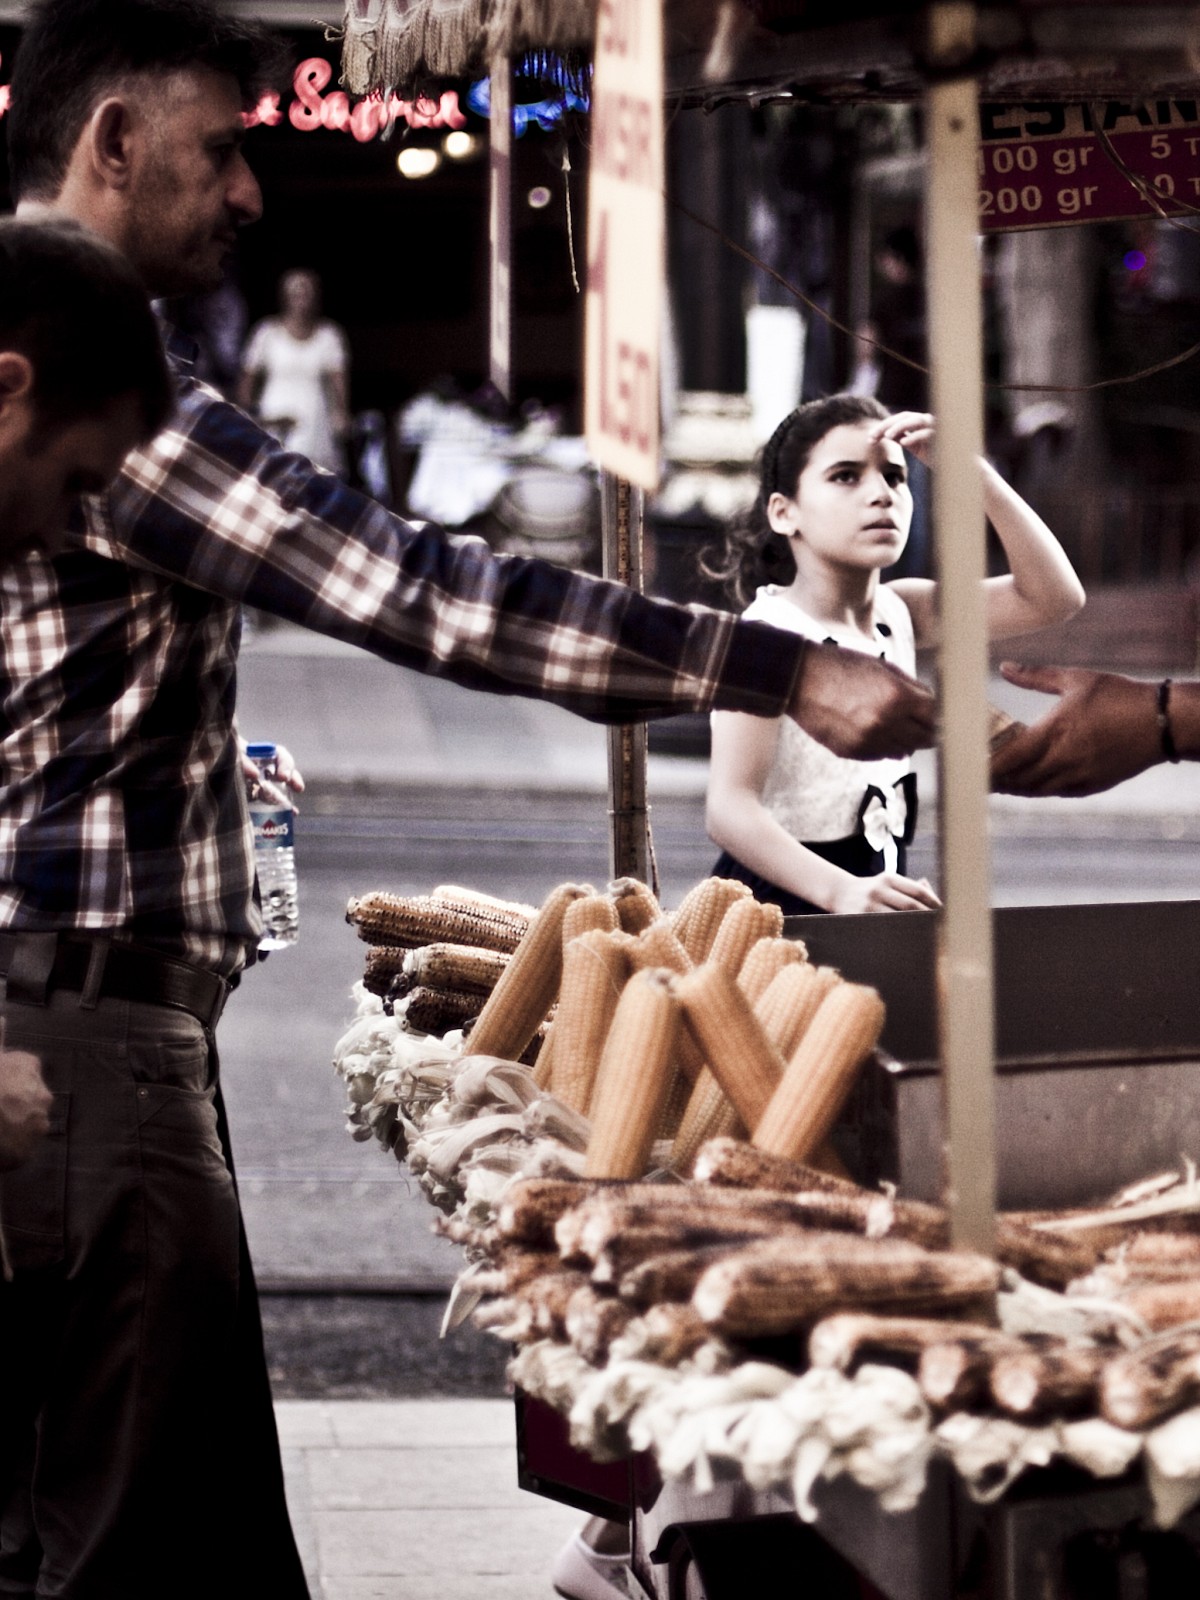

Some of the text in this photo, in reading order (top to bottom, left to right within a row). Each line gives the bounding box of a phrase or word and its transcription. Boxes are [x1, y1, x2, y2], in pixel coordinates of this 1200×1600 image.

[1052, 146, 1095, 175] gr
[1150, 133, 1172, 160] 5
[977, 184, 1043, 216] 200
[1056, 185, 1099, 215] gr
